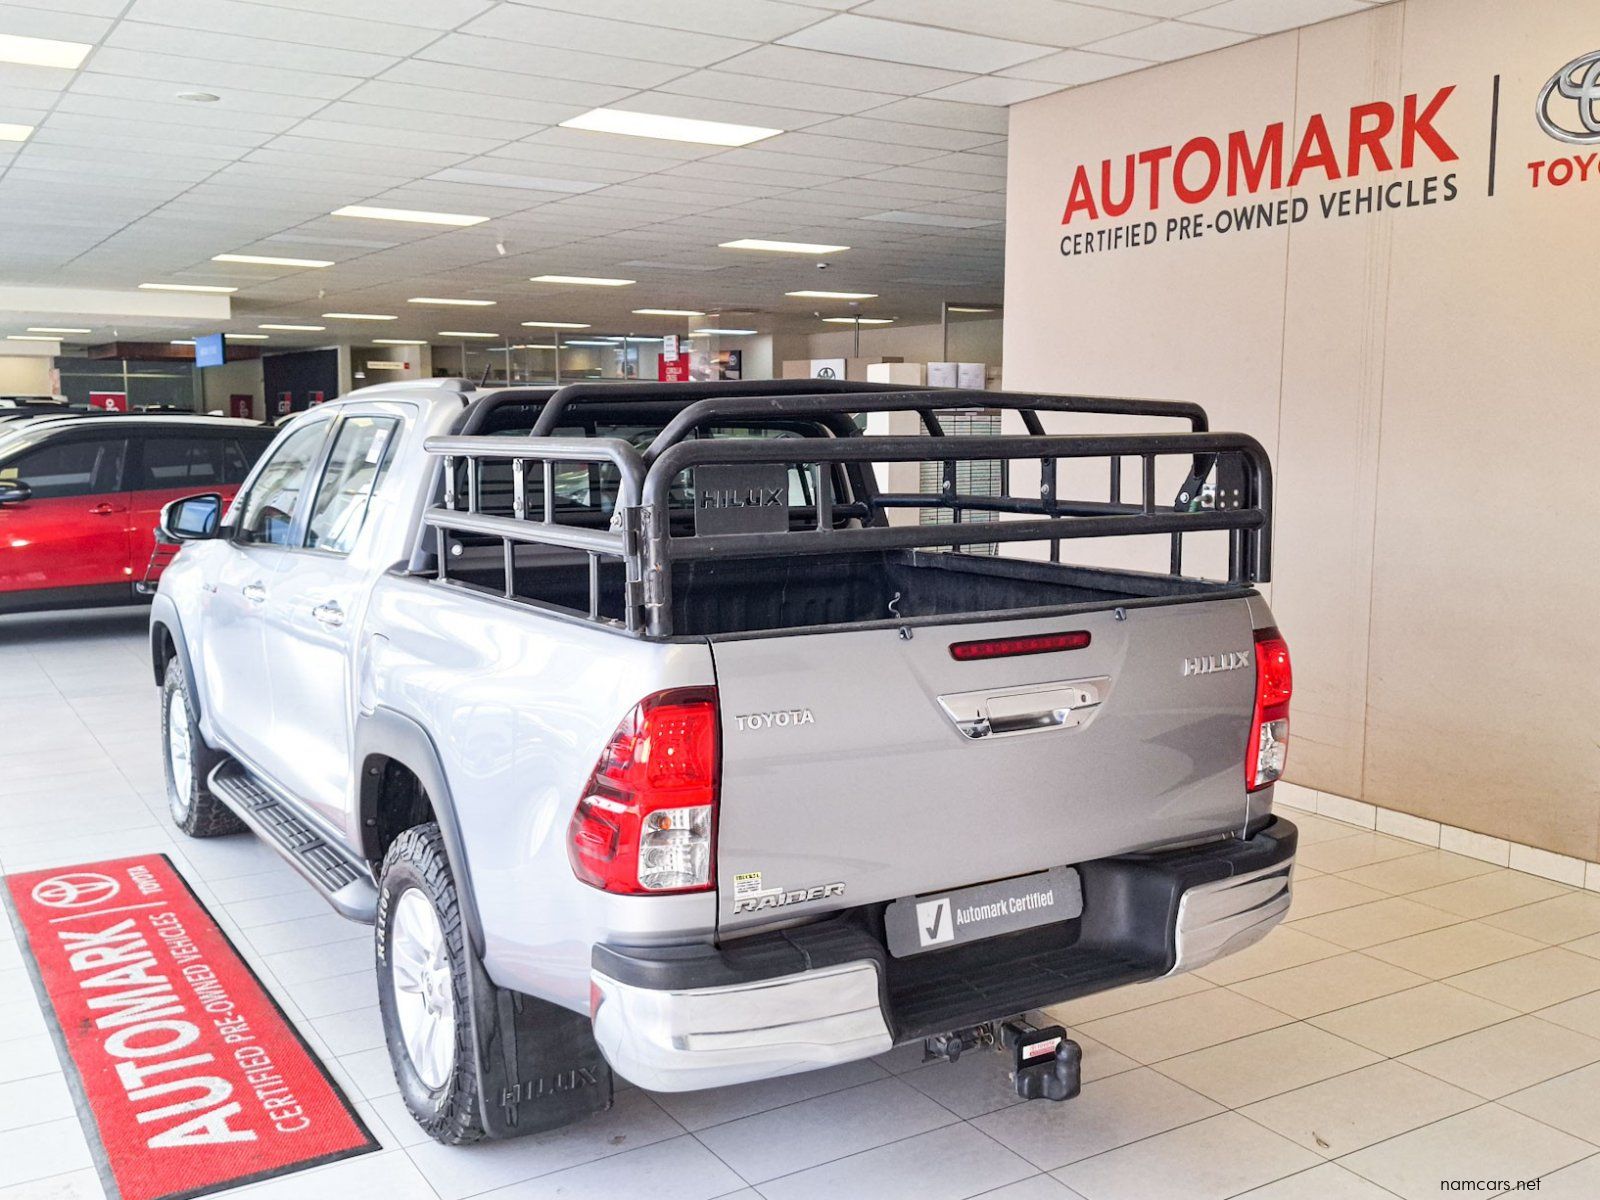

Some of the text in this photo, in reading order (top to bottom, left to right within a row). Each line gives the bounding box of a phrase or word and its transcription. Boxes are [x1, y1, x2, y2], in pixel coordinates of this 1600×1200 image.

[1061, 84, 1460, 225] AUTOMARK
[1527, 152, 1600, 188] TOY
[1059, 172, 1459, 257] CERTIFIED PRE-OWNED VEHICLES
[700, 487, 785, 510] HILUX
[1183, 650, 1250, 677] HILUX
[734, 707, 816, 732] TOYOTA
[733, 882, 846, 915] RAIDER
[956, 889, 1055, 925] Automark Certified
[58, 918, 258, 1149] AUTOMARK
[148, 911, 312, 1134] CERTIFIED PRE-OWNED VEHICLES
